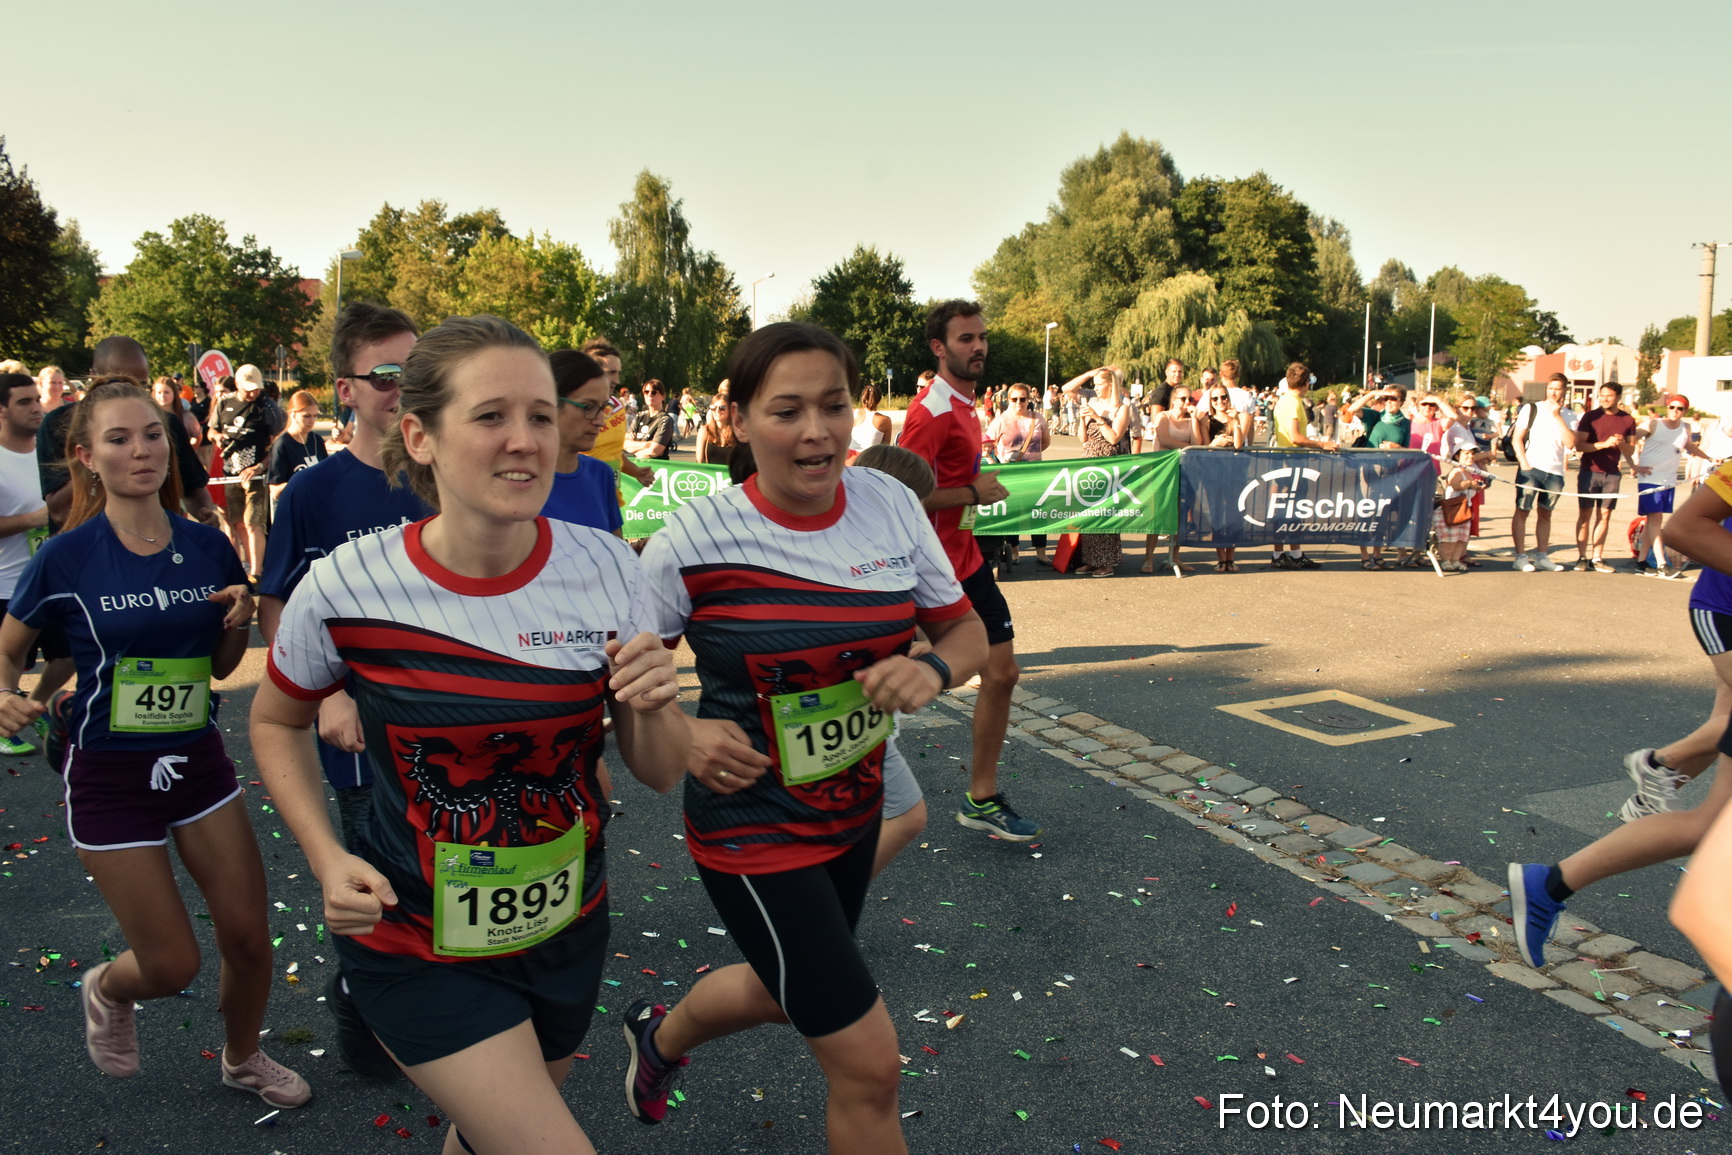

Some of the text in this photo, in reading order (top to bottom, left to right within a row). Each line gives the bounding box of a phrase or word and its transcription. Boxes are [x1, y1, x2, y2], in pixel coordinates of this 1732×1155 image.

[1035, 465, 1142, 507] AOK
[1031, 508, 1047, 519] Die
[1267, 491, 1391, 519] Fischer
[626, 509, 644, 520] Die
[1276, 521, 1378, 533] AUTOMOBILE
[518, 630, 604, 647] NEUMARKT
[135, 684, 195, 711] 497
[168, 711, 193, 721] Sophia
[796, 704, 884, 757] 1908
[458, 863, 518, 875] firmenlauf
[458, 869, 570, 926] 1893
[487, 916, 550, 938] Knotz Lisa
[487, 935, 510, 946] Stadt
